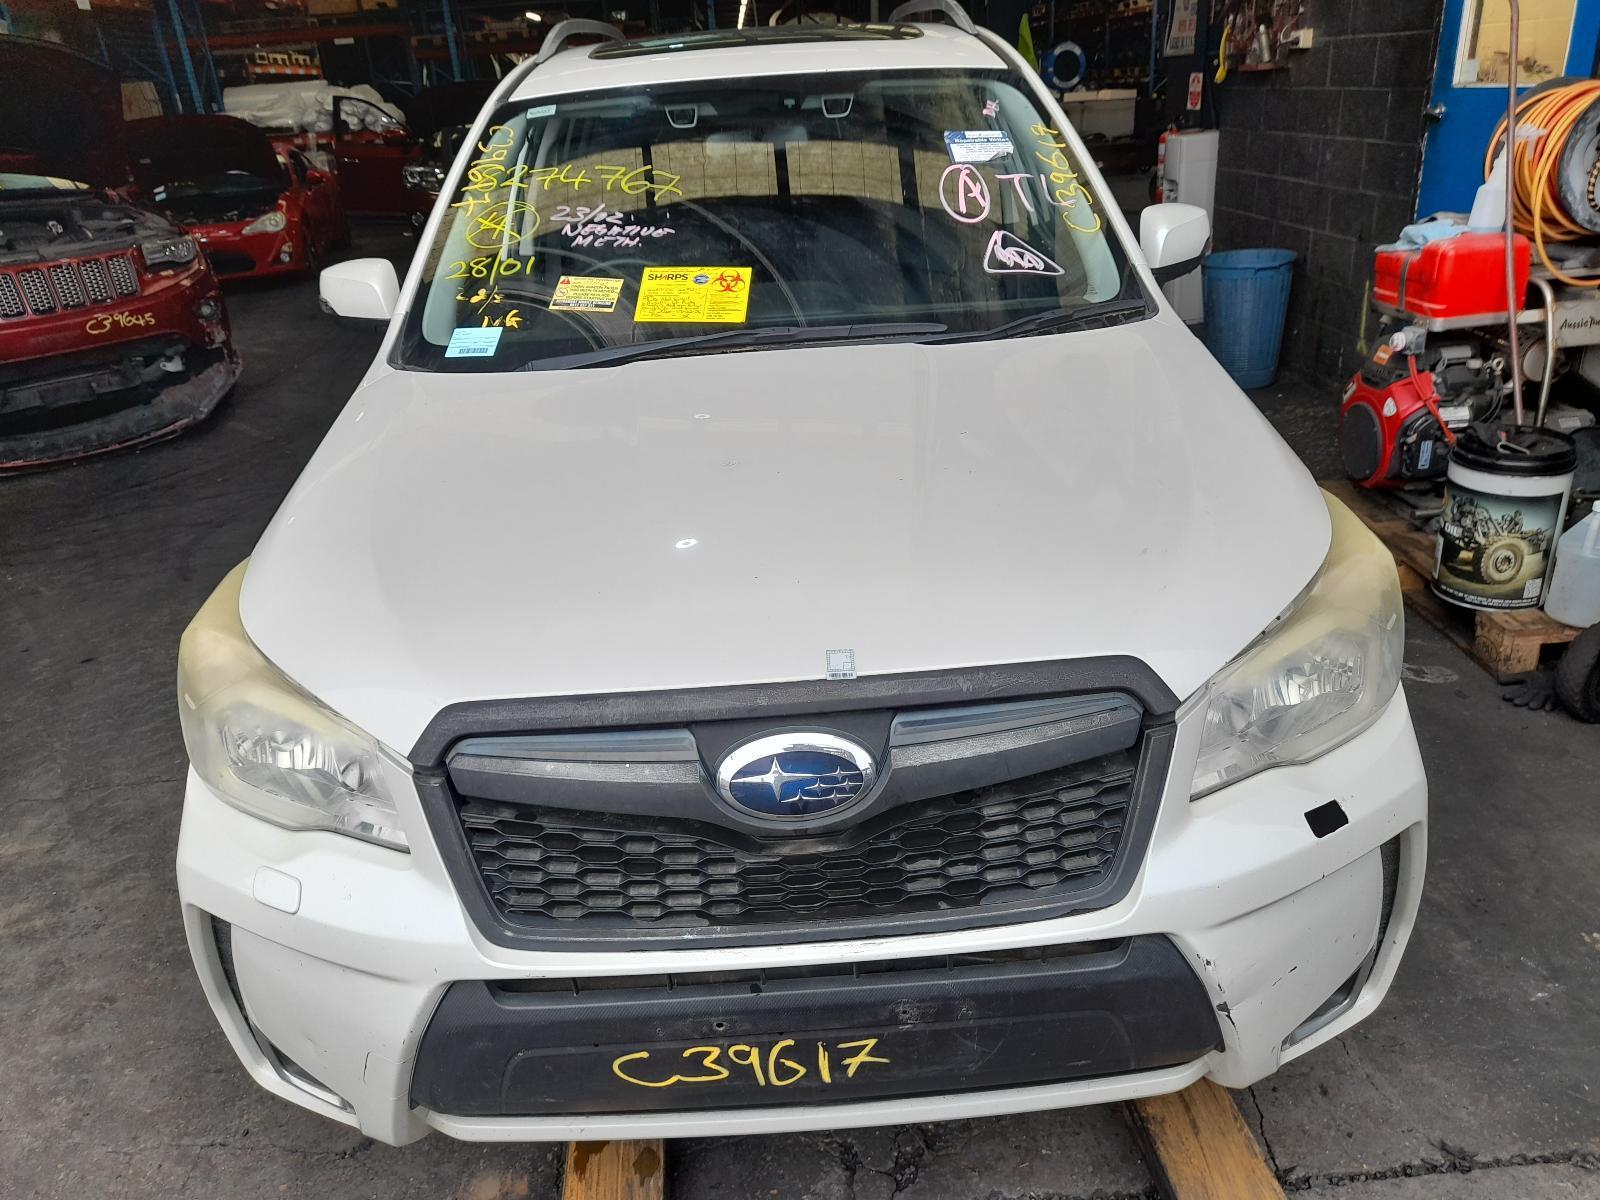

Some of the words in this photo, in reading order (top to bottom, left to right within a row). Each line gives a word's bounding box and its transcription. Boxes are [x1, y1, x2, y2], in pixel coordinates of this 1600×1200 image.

[561, 223, 676, 237] NEGATIVE
[445, 247, 535, 286] 28/01
[647, 273, 689, 281] SHARPS
[86, 311, 156, 334] C39645
[1559, 317, 1588, 331] Aussie
[612, 1038, 891, 1087] C39617
